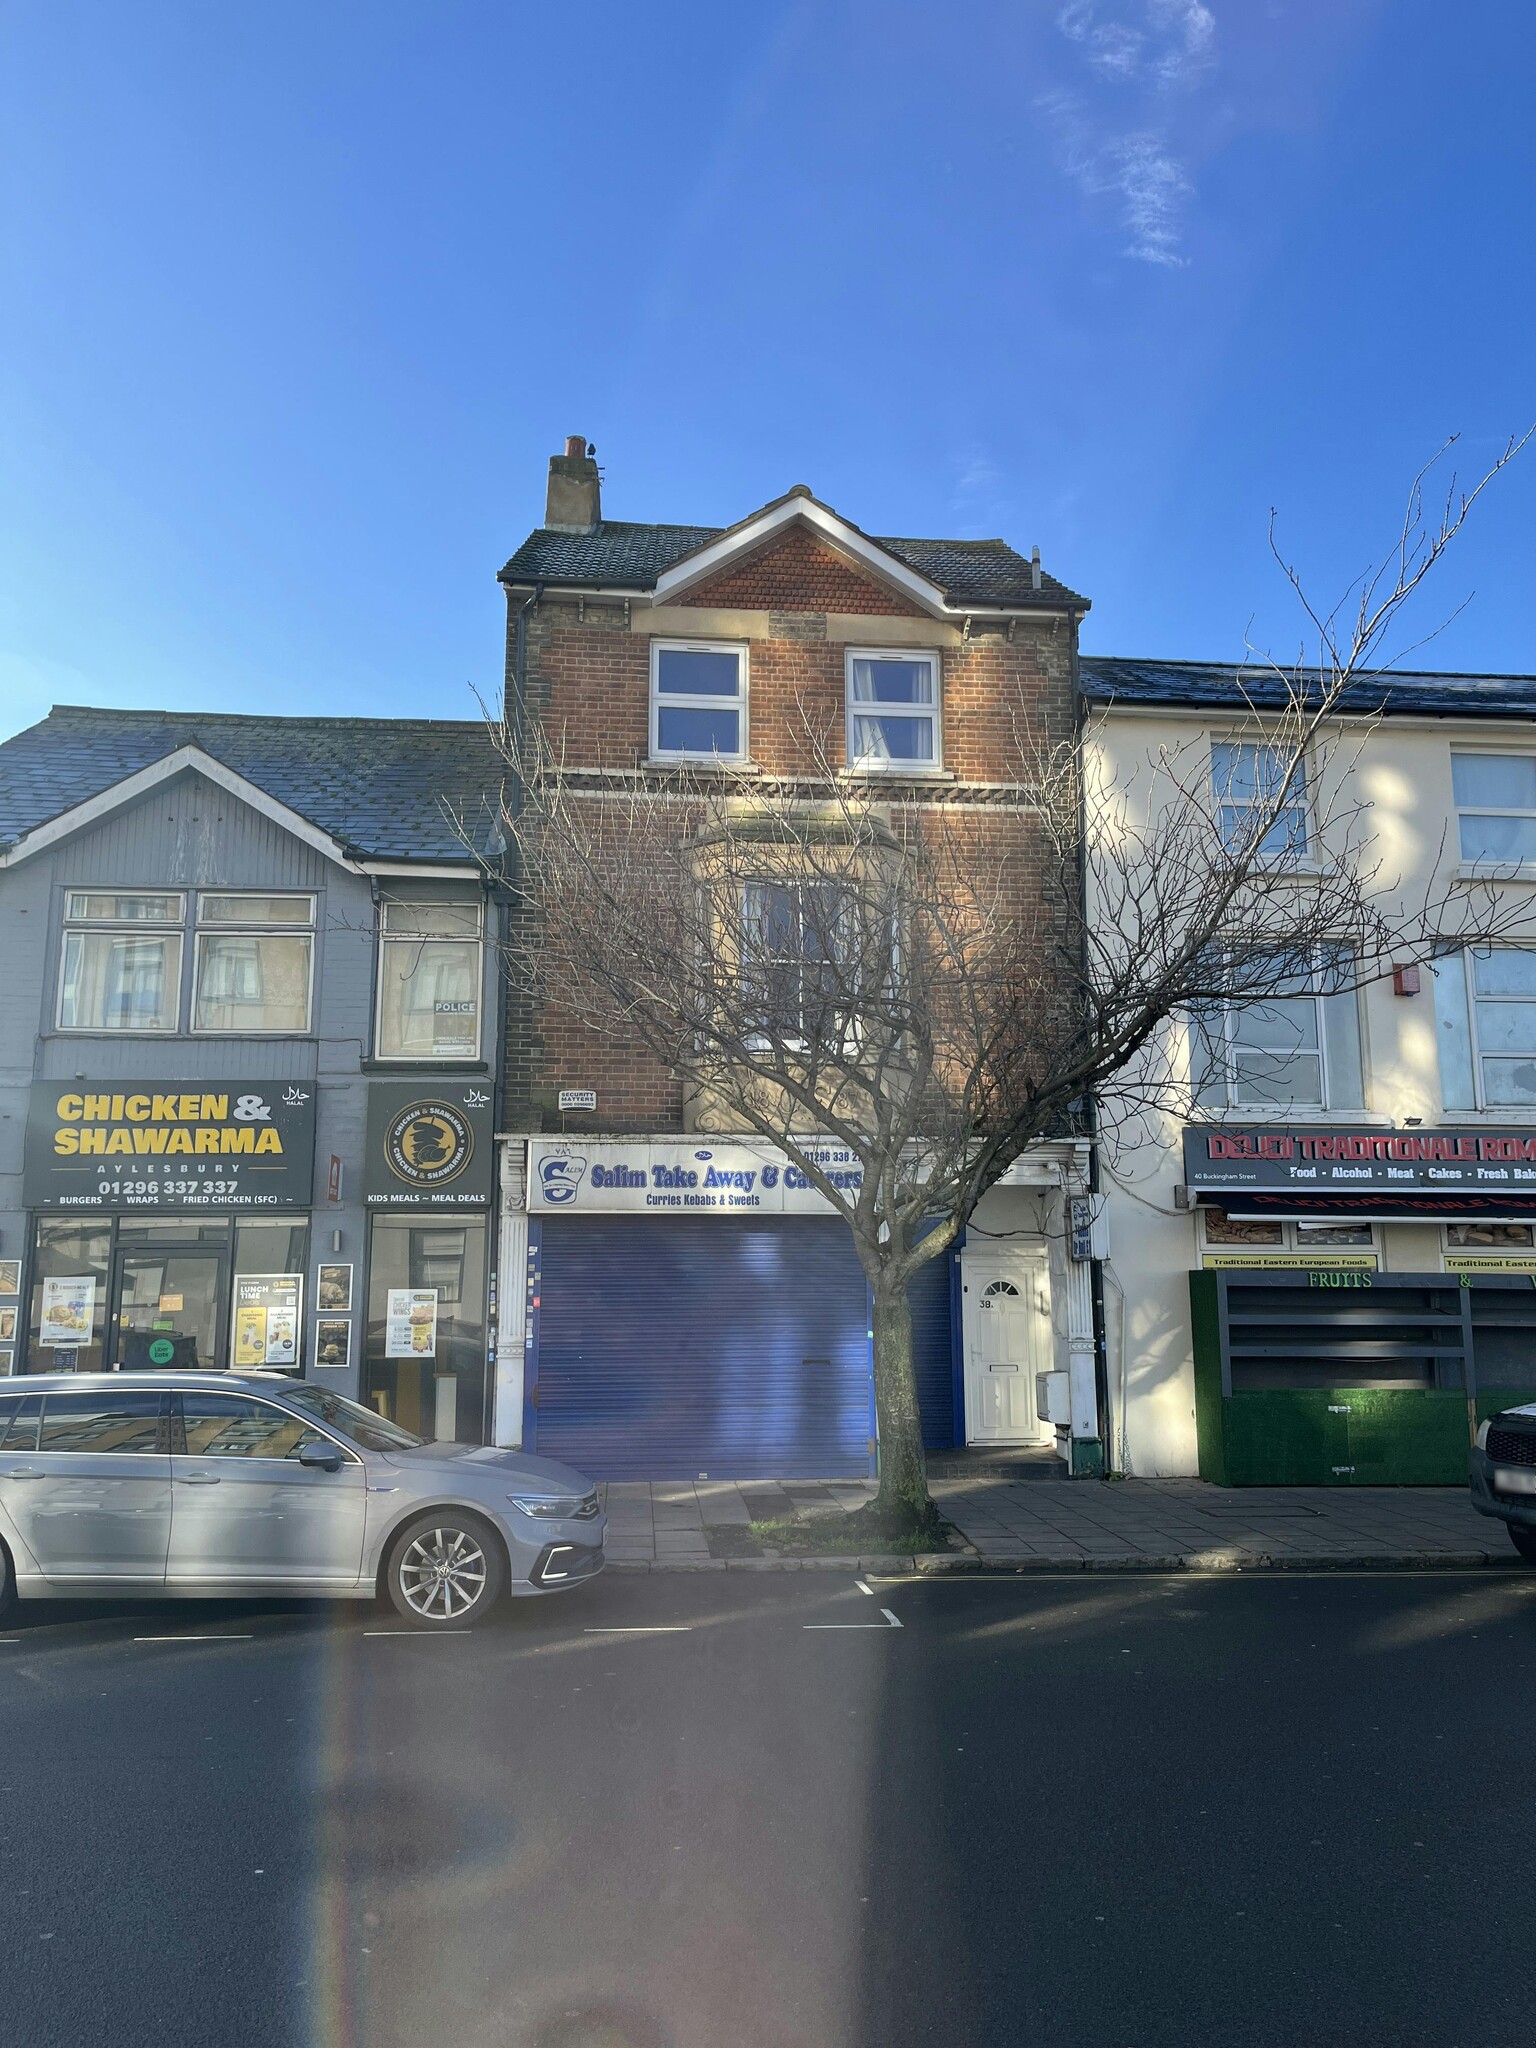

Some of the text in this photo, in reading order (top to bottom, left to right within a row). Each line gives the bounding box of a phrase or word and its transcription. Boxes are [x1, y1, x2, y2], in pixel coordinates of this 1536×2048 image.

[435, 1003, 476, 1011] POLICE
[56, 1094, 272, 1121] CHICKEN &
[394, 1109, 420, 1137] CHICKEN
[429, 1107, 465, 1137] SHAWARMA
[54, 1128, 284, 1154] SHAWARMA
[1296, 1136, 1478, 1161] TRADITIONALE
[833, 1151, 849, 1162] 338
[97, 1164, 240, 1174] AYLESBURY
[393, 1147, 418, 1177] CHICKEN
[427, 1147, 465, 1180] SHAWARMA
[591, 1164, 647, 1188] Salim
[652, 1164, 699, 1188] Take
[702, 1165, 757, 1193] Away
[761, 1165, 779, 1189] &
[1203, 1173, 1238, 1181] Buckingham
[1290, 1166, 1317, 1178] Food
[1332, 1167, 1373, 1178] Alcohol
[1387, 1168, 1415, 1179] Meat
[1428, 1167, 1462, 1179] Cakes
[1477, 1168, 1509, 1179] Fresh
[98, 1181, 238, 1194] 01296 337 337
[60, 1196, 102, 1204] BURGERS
[126, 1196, 159, 1204] WRAPS
[254, 1195, 278, 1204] (SFC)
[368, 1194, 486, 1202] KIDS MEALS MEAL DEALS
[646, 1194, 760, 1206] Curries Kebabs & Sweets
[1300, 1258, 1340, 1267] European
[1309, 1272, 1474, 1288] FRUITS &
